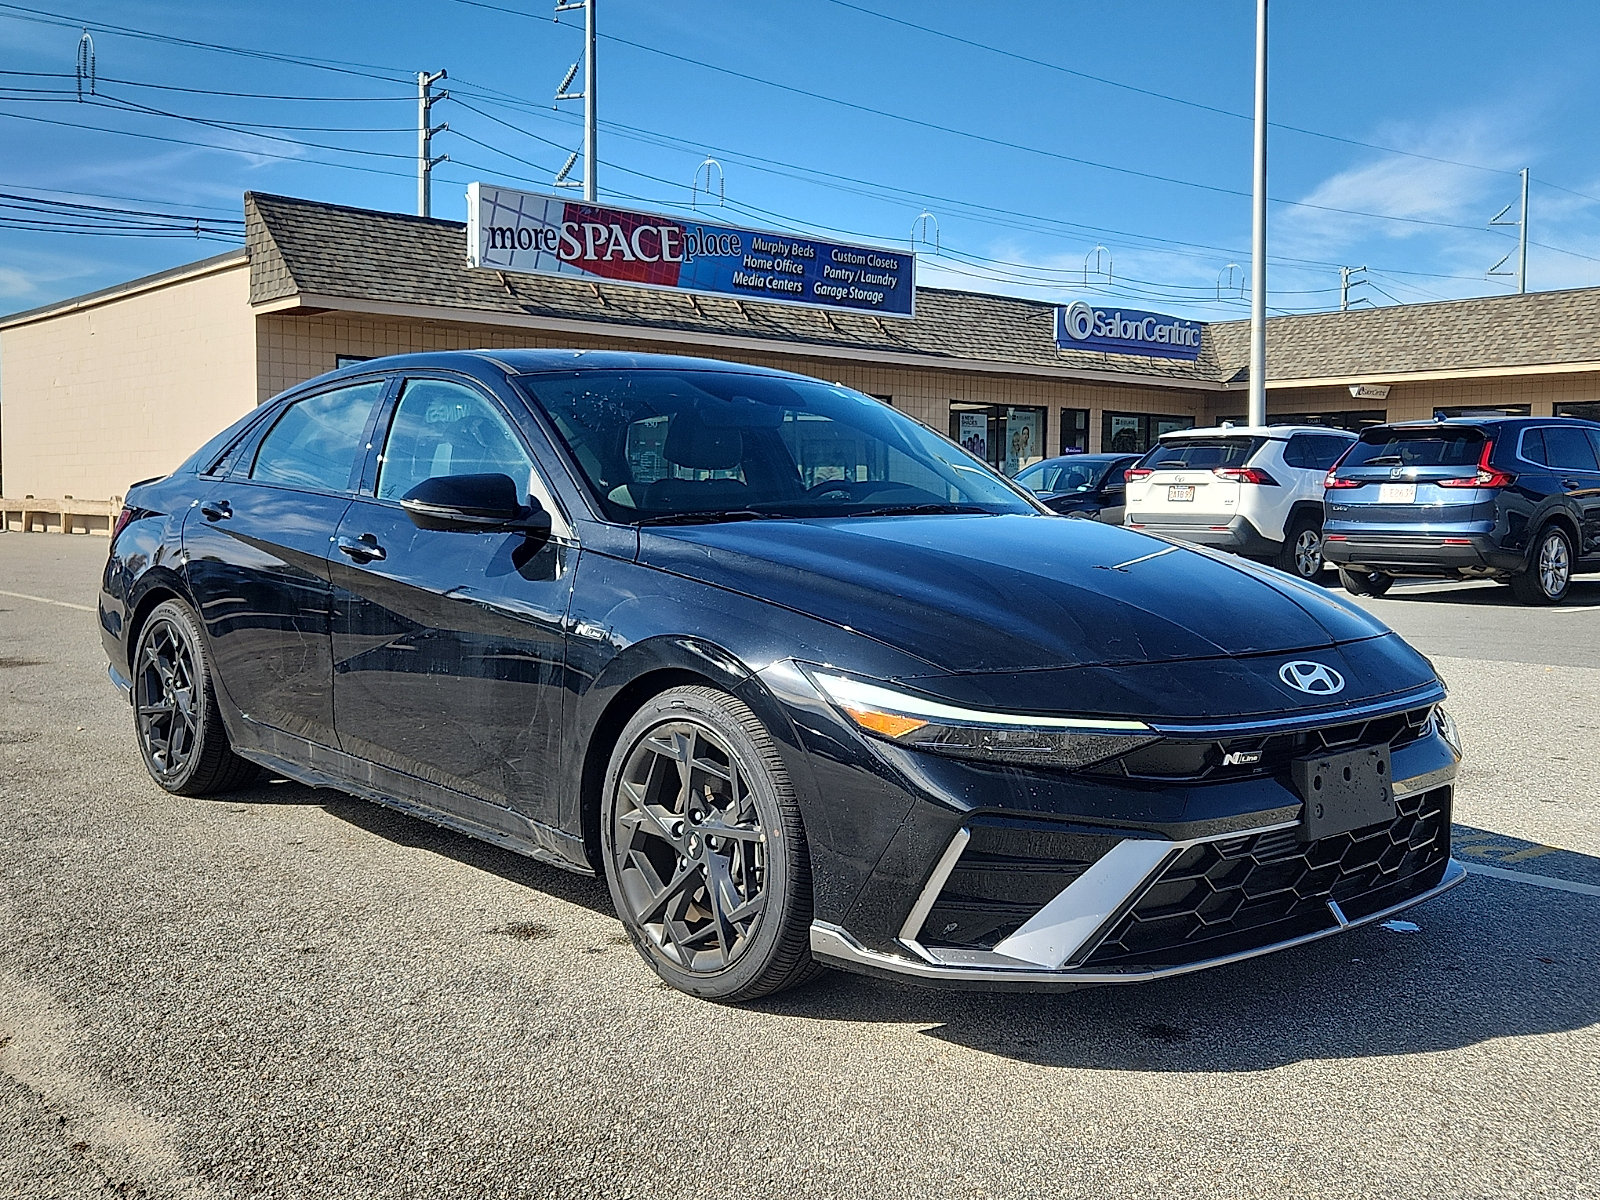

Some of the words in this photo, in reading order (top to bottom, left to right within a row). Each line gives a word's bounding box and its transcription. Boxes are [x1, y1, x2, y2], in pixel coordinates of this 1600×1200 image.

[487, 225, 558, 251] more
[559, 221, 683, 263] SPACE
[683, 227, 741, 263] place
[751, 237, 790, 257] Murphy
[791, 243, 815, 258] Beds
[743, 254, 773, 270] Home
[774, 258, 803, 274] Office
[831, 249, 866, 265] Custom
[867, 254, 898, 269] Closets
[732, 271, 765, 287] Media
[765, 276, 803, 292] Centers
[823, 265, 855, 283] Pantry
[861, 270, 898, 289] Laundry
[813, 282, 848, 300] Garage
[848, 286, 884, 304] Storage
[1092, 310, 1200, 347] SalonCentric
[1222, 752, 1240, 766] N
